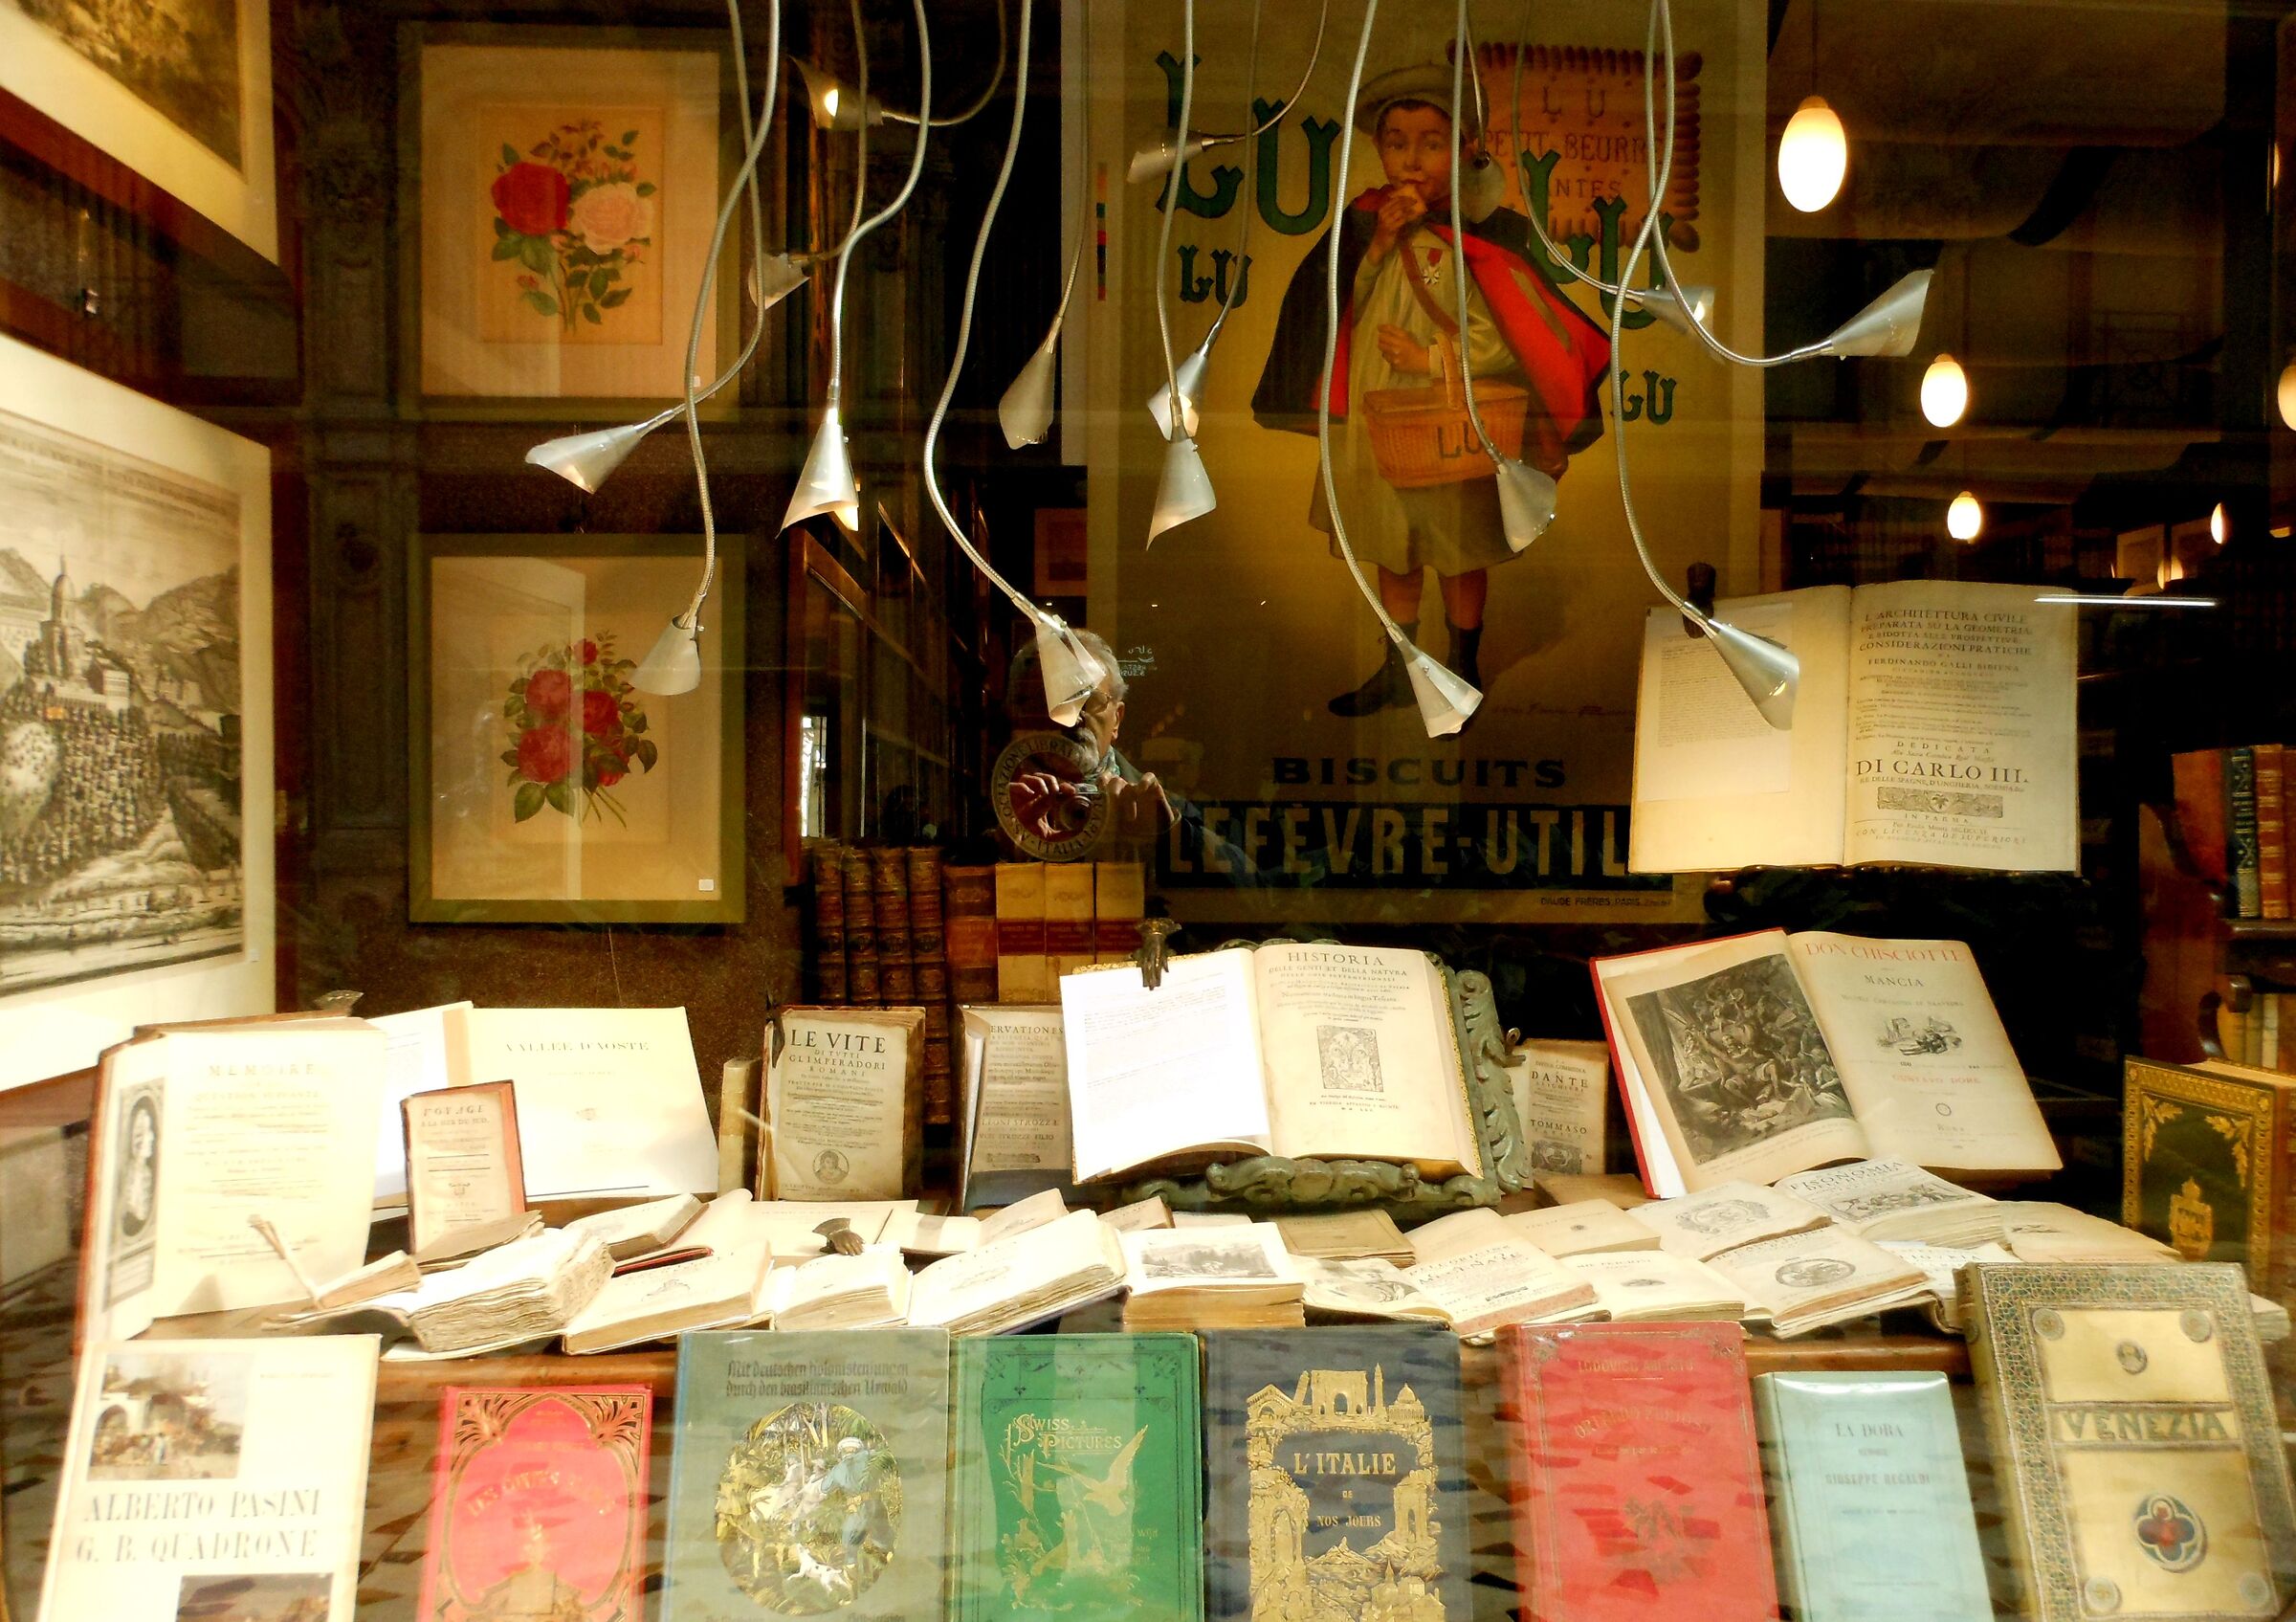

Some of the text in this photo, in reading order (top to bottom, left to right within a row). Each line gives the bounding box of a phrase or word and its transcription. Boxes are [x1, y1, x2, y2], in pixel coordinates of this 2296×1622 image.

[1155, 50, 1341, 235] LU
[1178, 245, 1252, 309] LU
[1859, 640, 2032, 655] CONSIDERAZIONI PRATICHE
[1271, 756, 1567, 789] BISCUITS
[1856, 759, 1884, 776] DI
[1893, 760, 1982, 780] CARLO
[1288, 951, 1385, 967] HISTORIA
[1804, 943, 1846, 957] DON
[1341, 967, 1367, 975] DELLA
[990, 1025, 1063, 1034] ERVATIONES
[790, 1029, 886, 1054] LE VITE
[809, 1066, 865, 1078] ROMANI
[1531, 1070, 1589, 1088] DANTE
[1531, 1119, 1588, 1135] TOMMASO
[1012, 1412, 1071, 1447] SWISS
[1835, 1422, 1855, 1437] LA
[2061, 1410, 2231, 1441] VENEZIA
[1038, 1433, 1123, 1459] PICTURES
[1293, 1452, 1397, 1476] L'ITALIE
[84, 1488, 320, 1522] ALBERTO PASINI
[1316, 1515, 1381, 1528] NOS JOURS
[77, 1529, 318, 1563] G. B. QUADRONE
